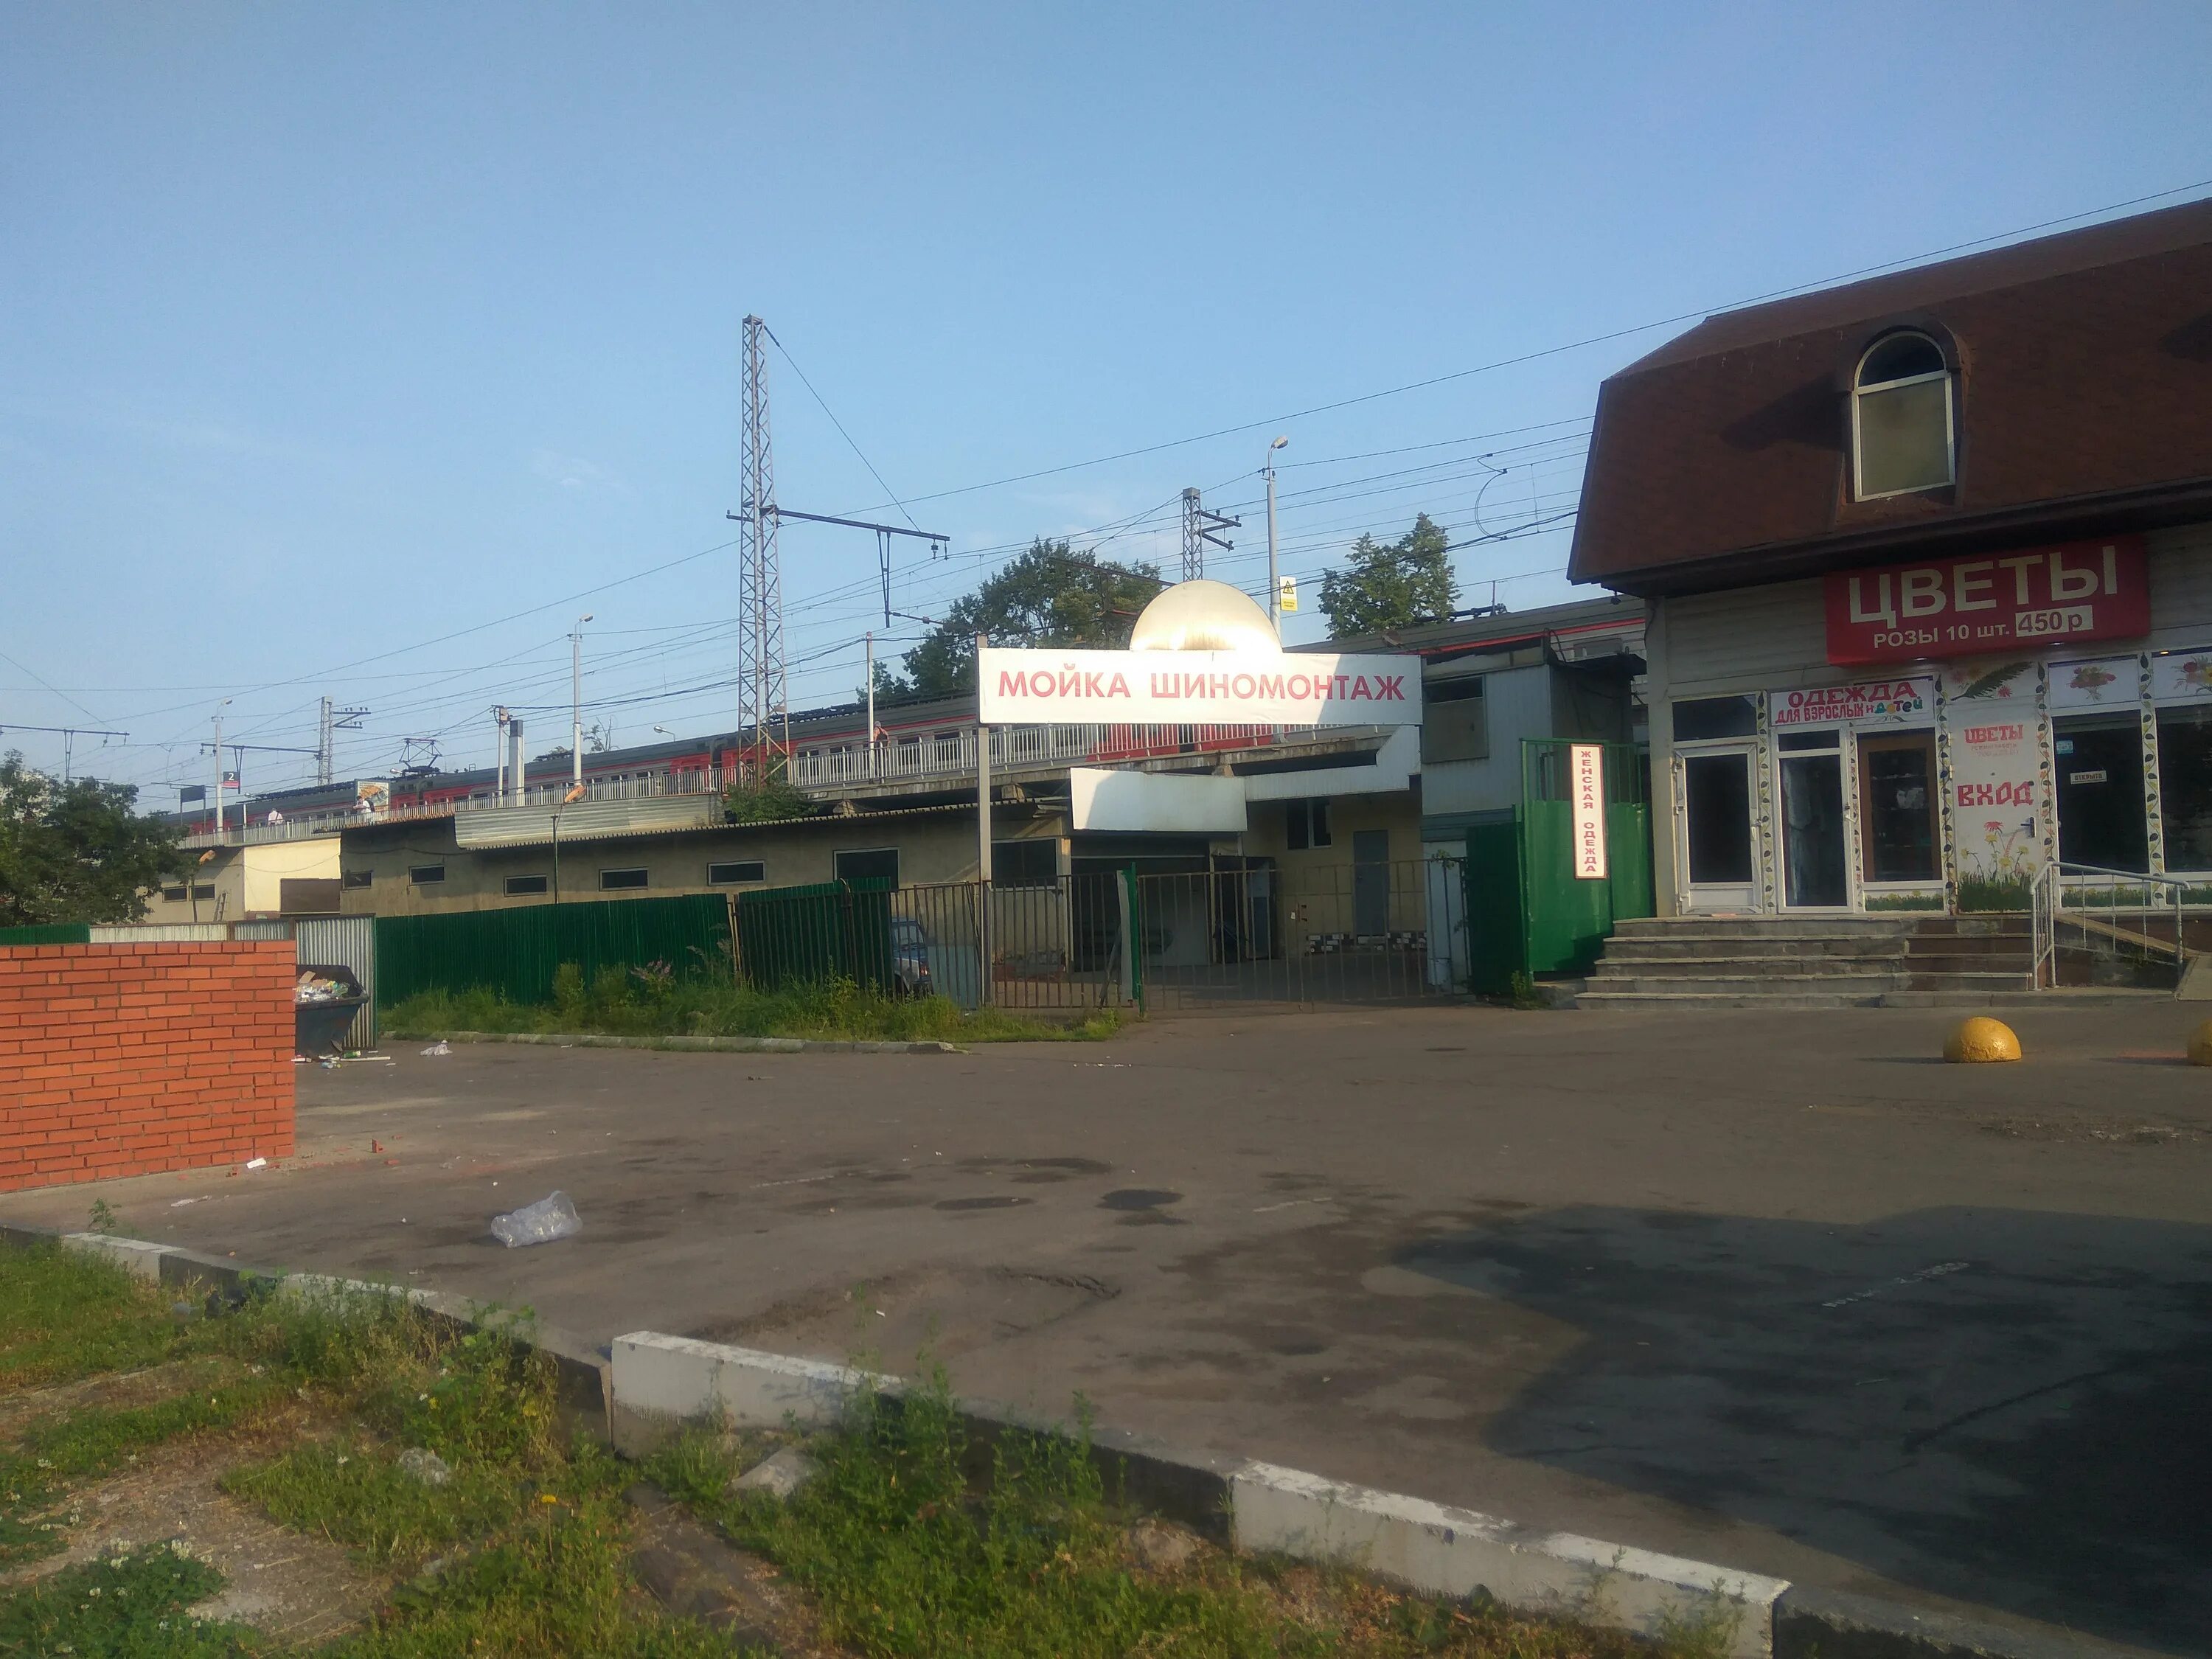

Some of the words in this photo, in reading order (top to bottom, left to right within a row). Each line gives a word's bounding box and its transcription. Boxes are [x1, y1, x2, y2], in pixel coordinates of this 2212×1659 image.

[1848, 545, 2118, 629] ЦВЕТЫ
[1874, 627, 1938, 648] РОЗЫ
[1947, 625, 1969, 640] 10
[1977, 623, 2010, 638] шт.
[998, 663, 1131, 698] МОЙКА
[1150, 672, 1405, 701] ШИНОМОНТАЖ
[1788, 681, 1917, 708] ОДЕЖДА
[1775, 708, 1801, 725] ДЛЯ
[1804, 703, 1864, 722] ВЗРОСЛЫХ
[1964, 724, 2024, 743] ЦВЕТЫ
[229, 772, 234, 781] 2
[1581, 751, 1593, 810] ЖЕНСКАЯ
[1958, 781, 2034, 807] ВХОД
[1584, 821, 1597, 872] ОДЕЖДА
